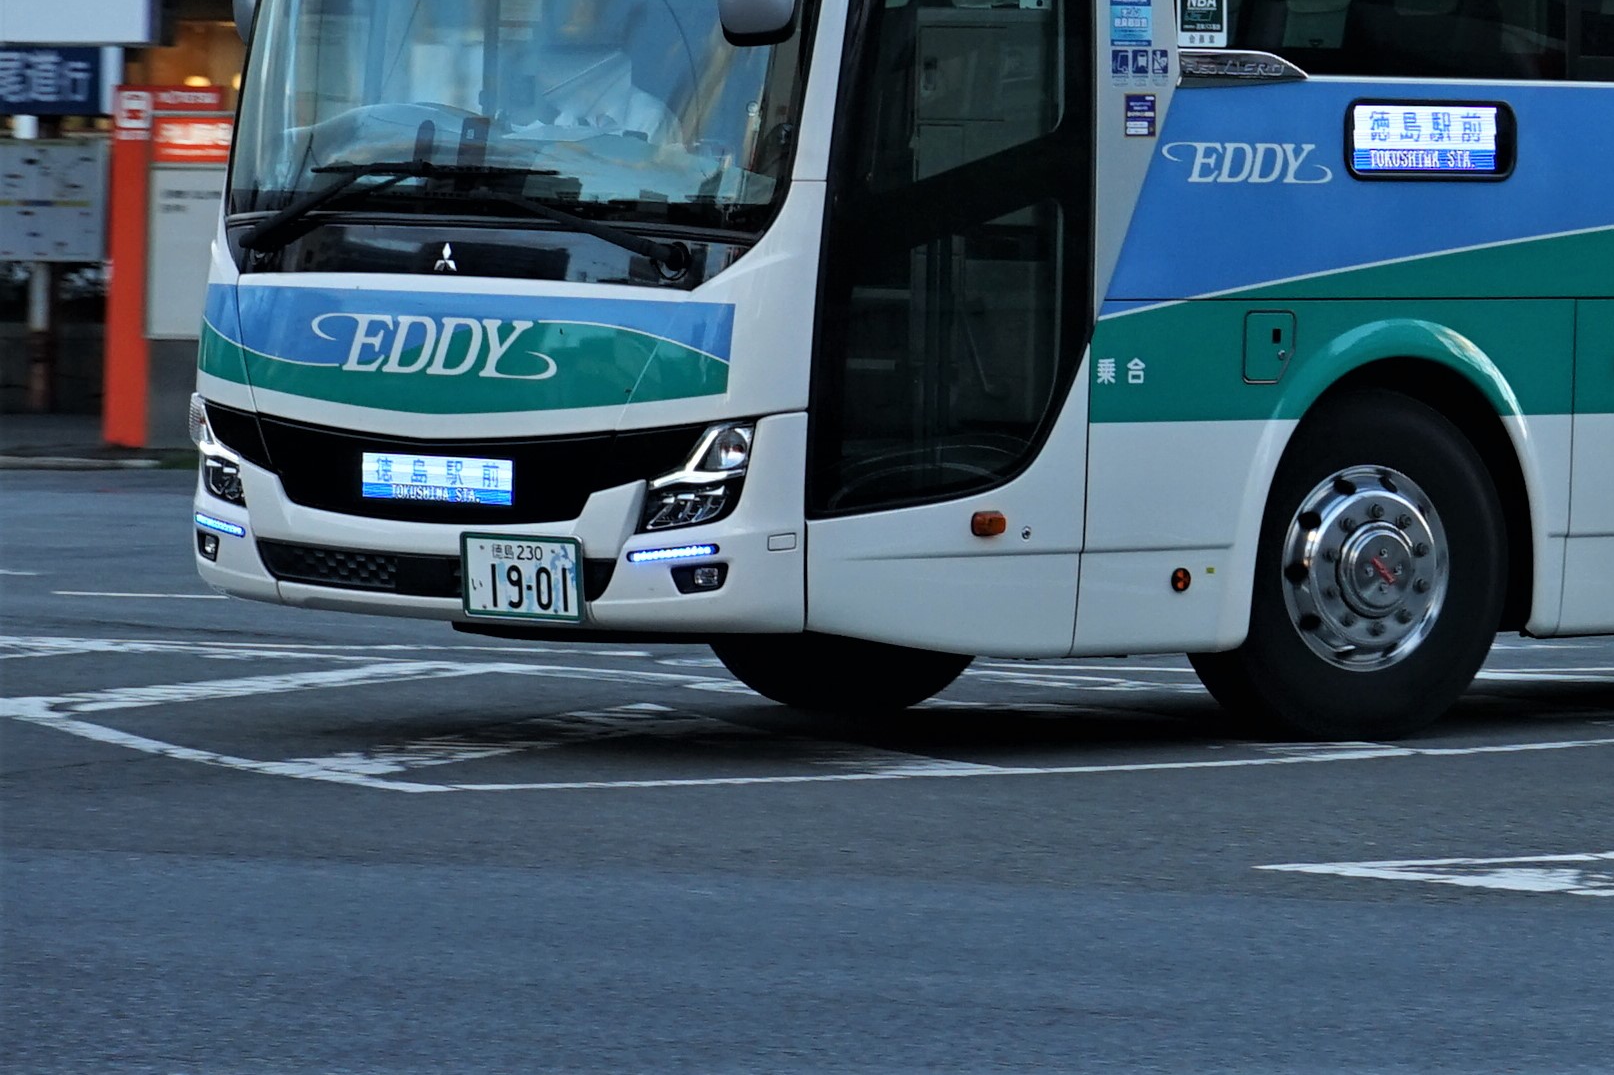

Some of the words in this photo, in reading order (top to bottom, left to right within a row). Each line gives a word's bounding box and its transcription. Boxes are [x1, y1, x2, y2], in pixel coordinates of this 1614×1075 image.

[1369, 110, 1483, 143] 徳島駅前
[1162, 141, 1333, 184] EDDY
[1369, 149, 1440, 168] TOKUSHIMA
[311, 312, 558, 380] EDDY
[1096, 357, 1146, 385] 乗合
[375, 456, 500, 488] 徳島駅前
[391, 483, 450, 501] TOKUSHIMA
[517, 544, 543, 561] 230
